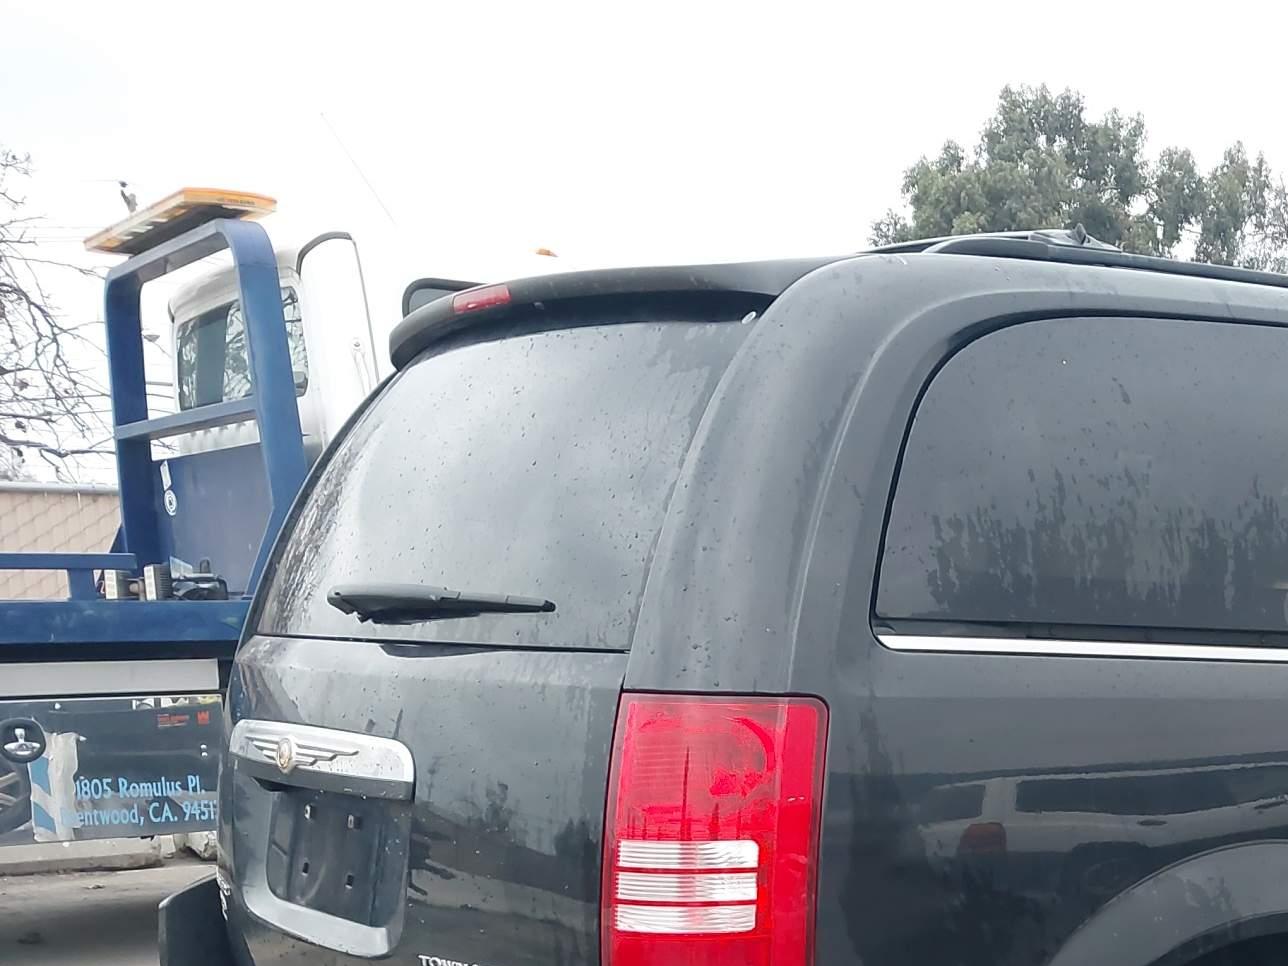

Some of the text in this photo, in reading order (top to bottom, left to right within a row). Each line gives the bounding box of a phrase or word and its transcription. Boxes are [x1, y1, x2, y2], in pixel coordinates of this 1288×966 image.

[118, 776, 183, 799] Romulus
[187, 775, 205, 795] Pl.
[149, 802, 178, 822] CA.
